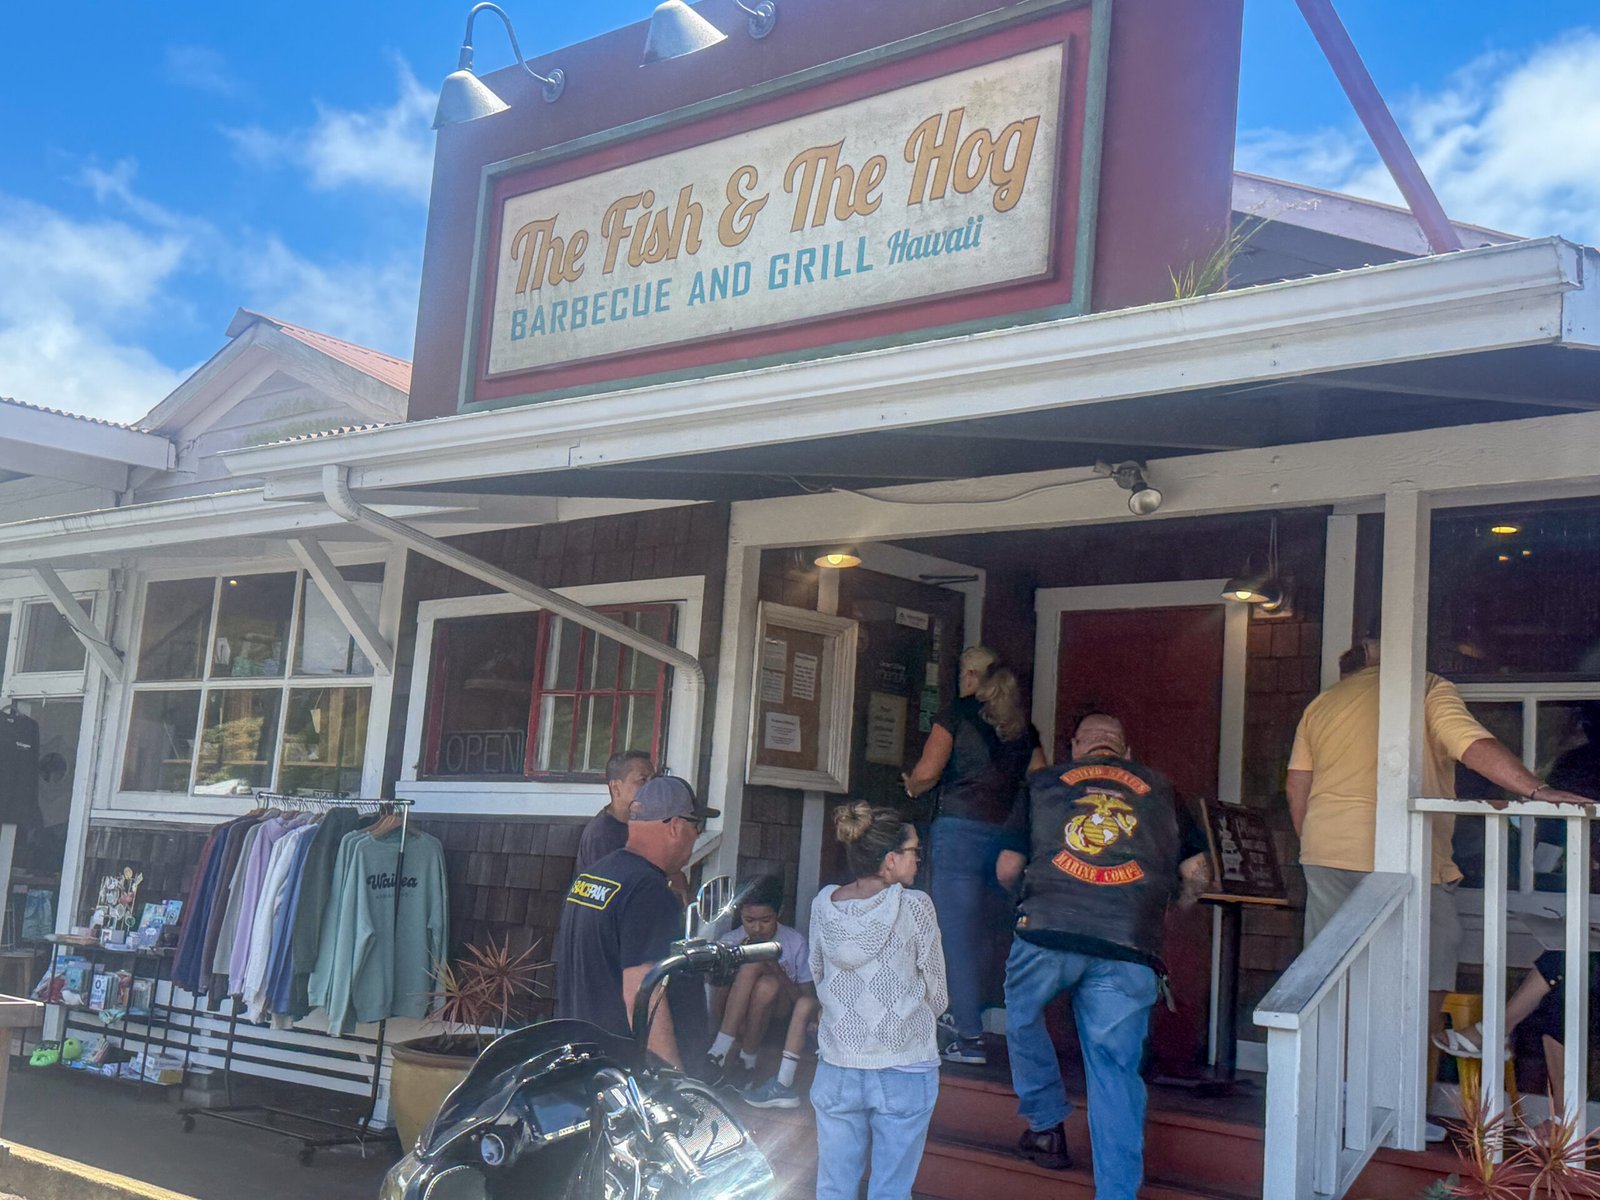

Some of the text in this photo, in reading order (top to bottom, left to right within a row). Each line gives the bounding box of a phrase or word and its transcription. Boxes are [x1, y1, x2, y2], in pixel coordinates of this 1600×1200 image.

[511, 107, 1040, 294] The Fish & The Hog
[511, 214, 984, 341] BARBECUE AND GRILL Hawaii
[446, 734, 520, 772] OPEN
[366, 872, 418, 890] Waiea
[1055, 852, 1141, 882] MARINE CORPS
